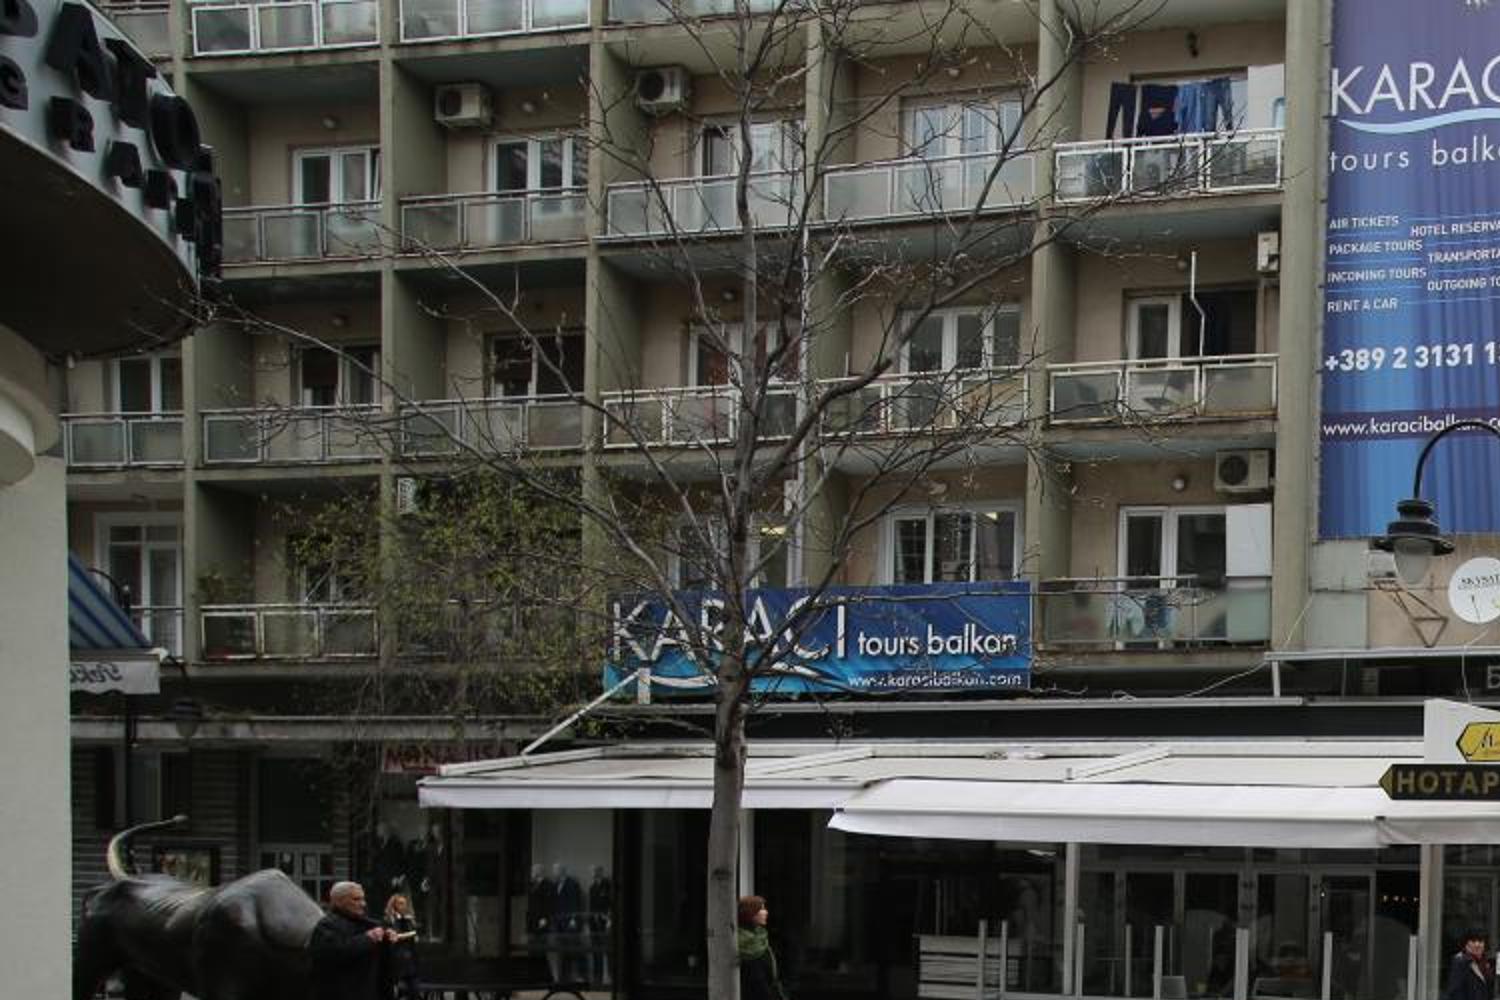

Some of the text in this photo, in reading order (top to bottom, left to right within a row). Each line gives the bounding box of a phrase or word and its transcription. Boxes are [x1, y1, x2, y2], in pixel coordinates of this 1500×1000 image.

[1329, 151, 1410, 172] tours
[1329, 216, 1399, 230] AIR TICKETS
[1410, 224, 1448, 238] HOTEL
[1329, 239, 1423, 255] PACKAGE TOURS
[1327, 267, 1427, 283] INCOMING TOURS
[1427, 278, 1487, 292] OUTGOING
[1327, 298, 1398, 313] RENT A CAR
[1325, 347, 1385, 371] +389
[1392, 347, 1408, 369] 2
[1415, 343, 1474, 368] 3131
[857, 630, 920, 656] tours
[927, 623, 1017, 656] balkan
